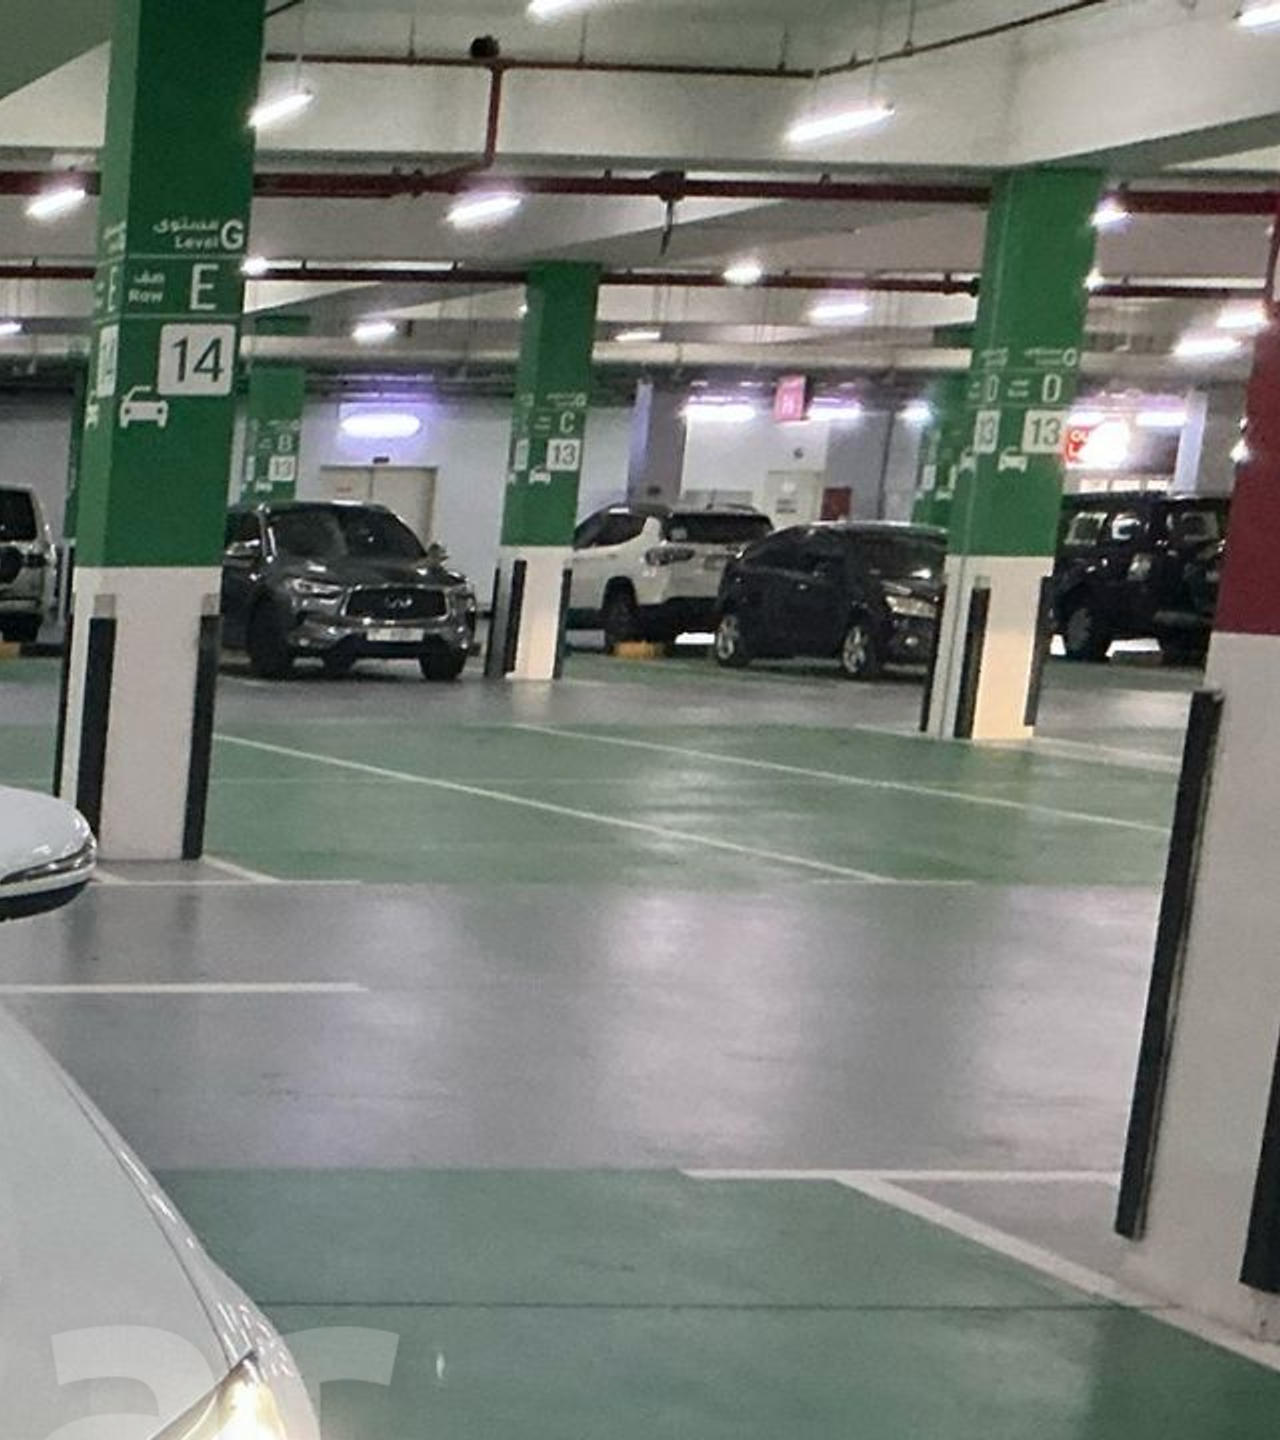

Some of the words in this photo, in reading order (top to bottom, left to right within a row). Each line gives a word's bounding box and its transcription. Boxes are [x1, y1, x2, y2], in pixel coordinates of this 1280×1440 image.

[174, 235, 218, 249] Level
[221, 219, 244, 250] G
[128, 290, 163, 303] Row
[190, 263, 219, 310] E
[172, 336, 223, 383] 14
[560, 411, 575, 433] C
[1030, 417, 1061, 446] 13
[553, 443, 576, 465] 13
